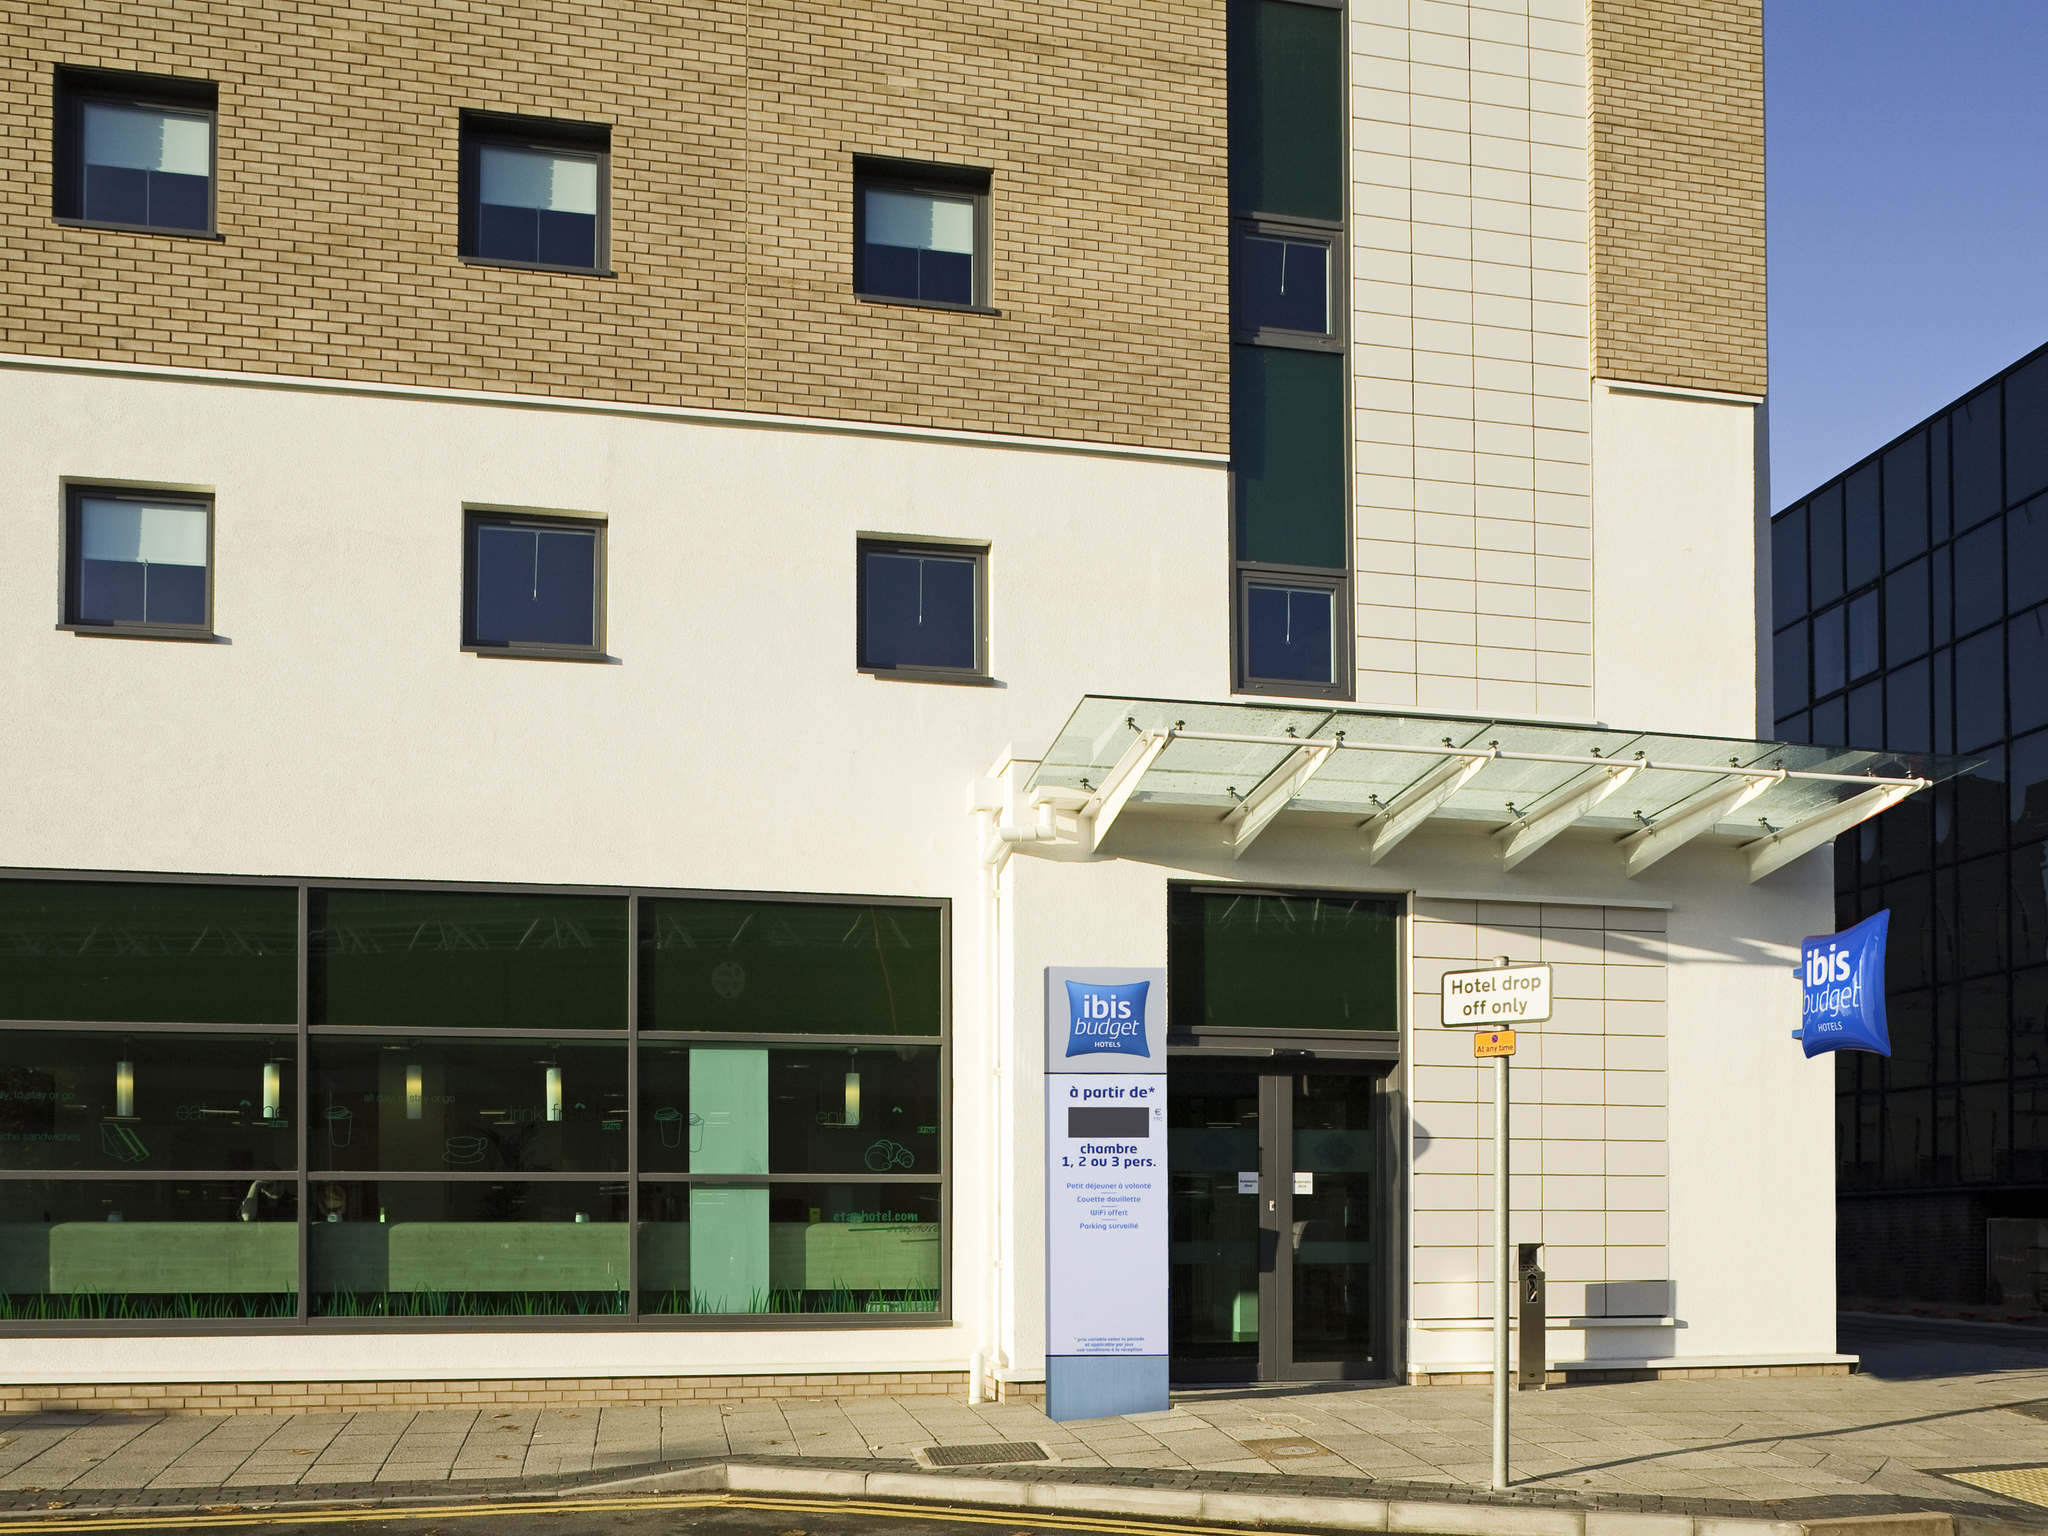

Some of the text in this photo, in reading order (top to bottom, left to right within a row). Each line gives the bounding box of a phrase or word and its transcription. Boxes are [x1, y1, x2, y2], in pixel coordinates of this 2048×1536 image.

[1806, 943, 1851, 988] ibis
[1452, 976, 1541, 995] Hotel drop
[1083, 994, 1131, 1019] ibis
[1463, 997, 1528, 1016] off only
[1803, 982, 1862, 1017] budget
[1074, 1017, 1140, 1040] budget
[1817, 1020, 1843, 1032] HOTELS
[1486, 1046, 1498, 1054] any
[1499, 1044, 1514, 1052] time
[1069, 1086, 1079, 1098] à
[1083, 1086, 1126, 1101] partir
[1080, 1143, 1138, 1154] chambre
[1062, 1156, 1157, 1169] 1, 2 ou 3 pers.
[1085, 1182, 1117, 1191] déjeuner
[1077, 1195, 1141, 1203] Couette douillette
[1080, 1222, 1107, 1230] Parking
